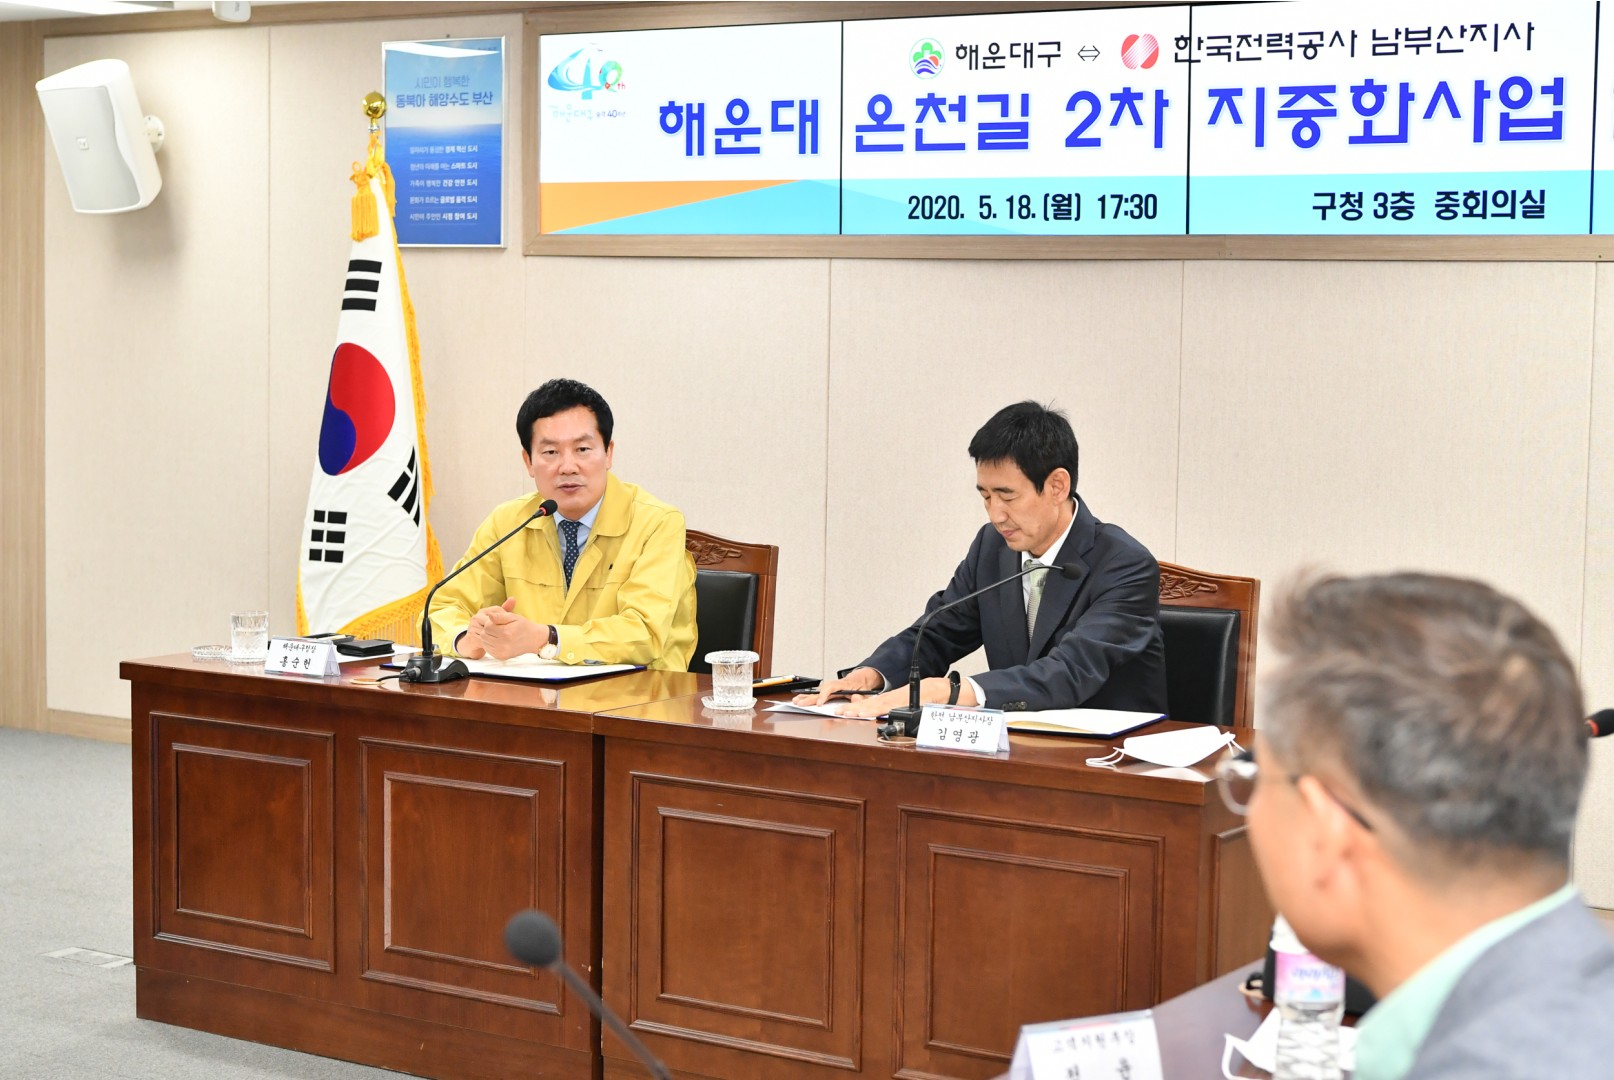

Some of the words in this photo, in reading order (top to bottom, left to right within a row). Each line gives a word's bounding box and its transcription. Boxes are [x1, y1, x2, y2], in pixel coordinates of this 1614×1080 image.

[956, 42, 1061, 70] 해운대구
[1174, 29, 1358, 63] 한국전력공사
[1372, 22, 1534, 56] 남부산지사
[414, 75, 441, 89] 시민이
[443, 74, 470, 88] 행복한
[396, 94, 426, 108] 동북아
[428, 91, 469, 107] 해양수도
[472, 90, 493, 105] 부산
[659, 98, 818, 156] 해운대
[856, 93, 1029, 152] 온천길
[1065, 87, 1169, 148] 2차
[1208, 76, 1564, 148] 지중화사업
[467, 144, 478, 152] 도시
[467, 161, 478, 170] 도시
[466, 178, 478, 187] 도시
[467, 195, 478, 203] 도시
[1312, 191, 1364, 221] 구청
[1373, 191, 1416, 221] 3층
[1434, 189, 1546, 220] 중회의실
[908, 194, 965, 221] 2020.
[978, 194, 998, 220] 5.
[1097, 193, 1158, 220] 17:30
[466, 212, 478, 220] 도시
[930, 711, 945, 721] 한전
[949, 712, 994, 725] 남부산지사장
